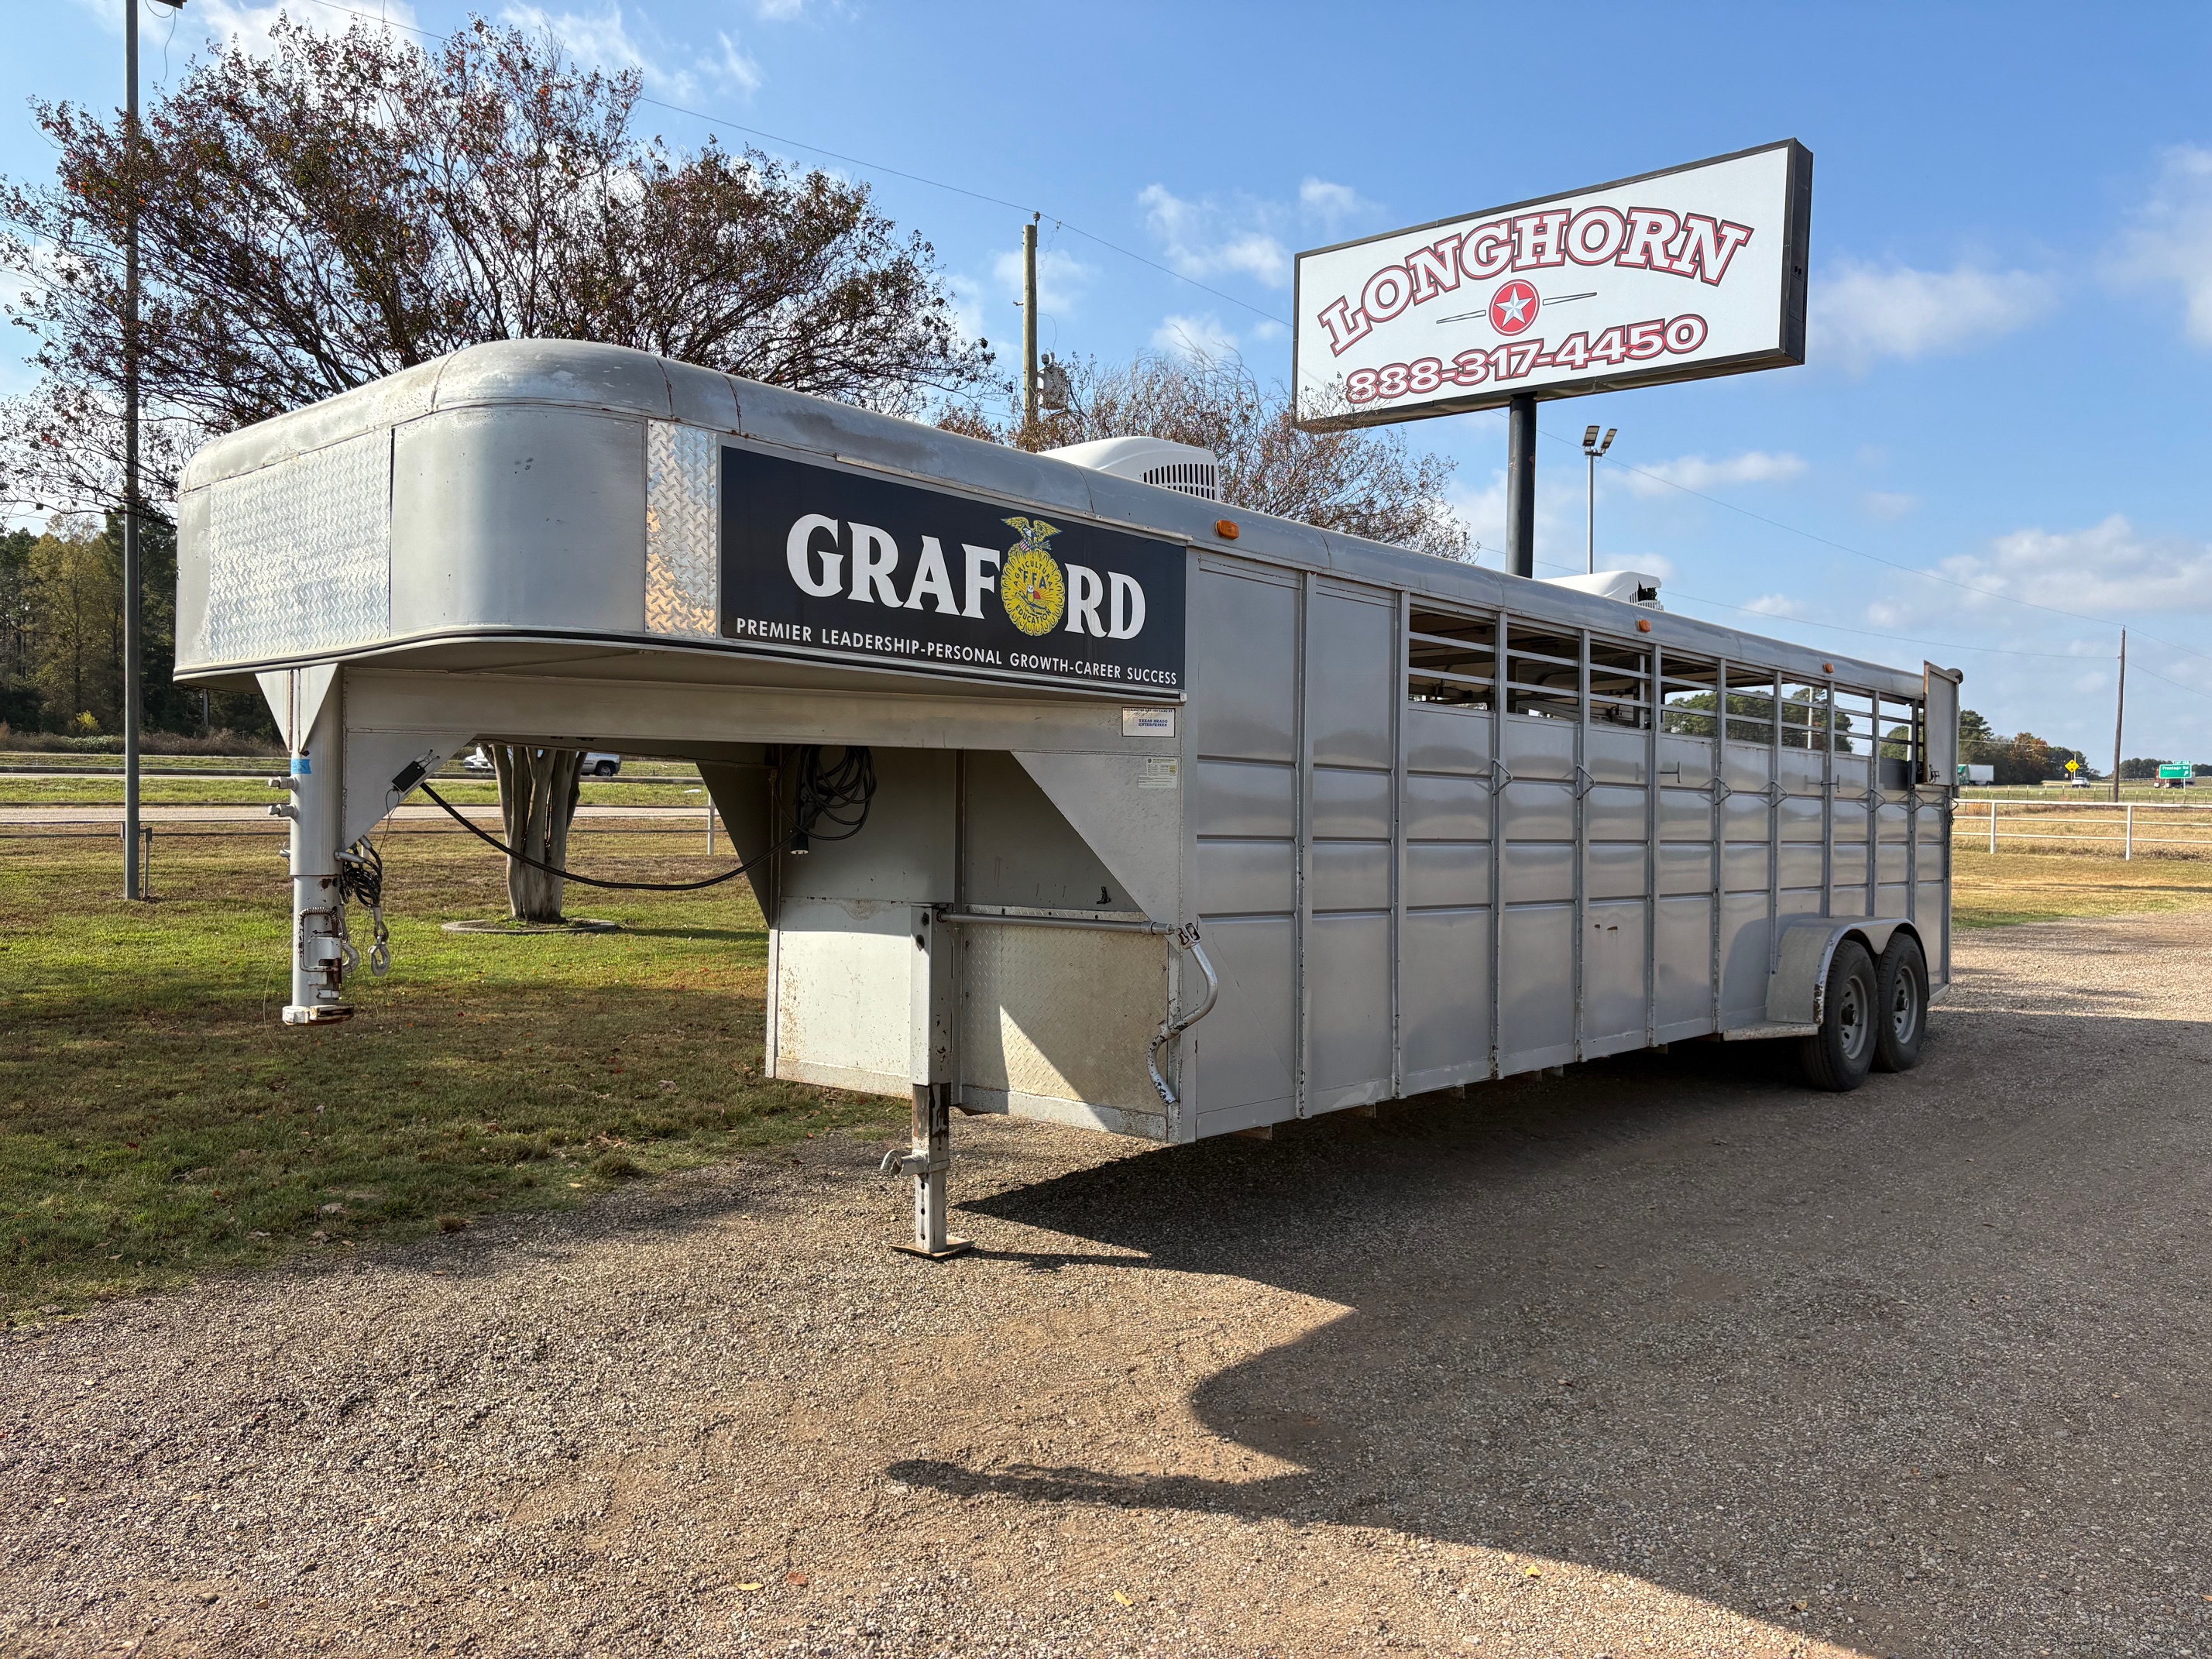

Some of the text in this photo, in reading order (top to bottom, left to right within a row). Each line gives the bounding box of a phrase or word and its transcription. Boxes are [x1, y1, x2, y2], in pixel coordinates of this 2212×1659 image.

[1317, 206, 1754, 357] LONGHORN
[1346, 314, 1709, 404] 888-317-4450
[1013, 560, 1054, 592] AGRICULTURAL
[1023, 570, 1047, 589] FFA
[1015, 604, 1052, 624] EDUCATION
[737, 617, 812, 643] PREMIER
[1127, 667, 1177, 685] SUCCESS
